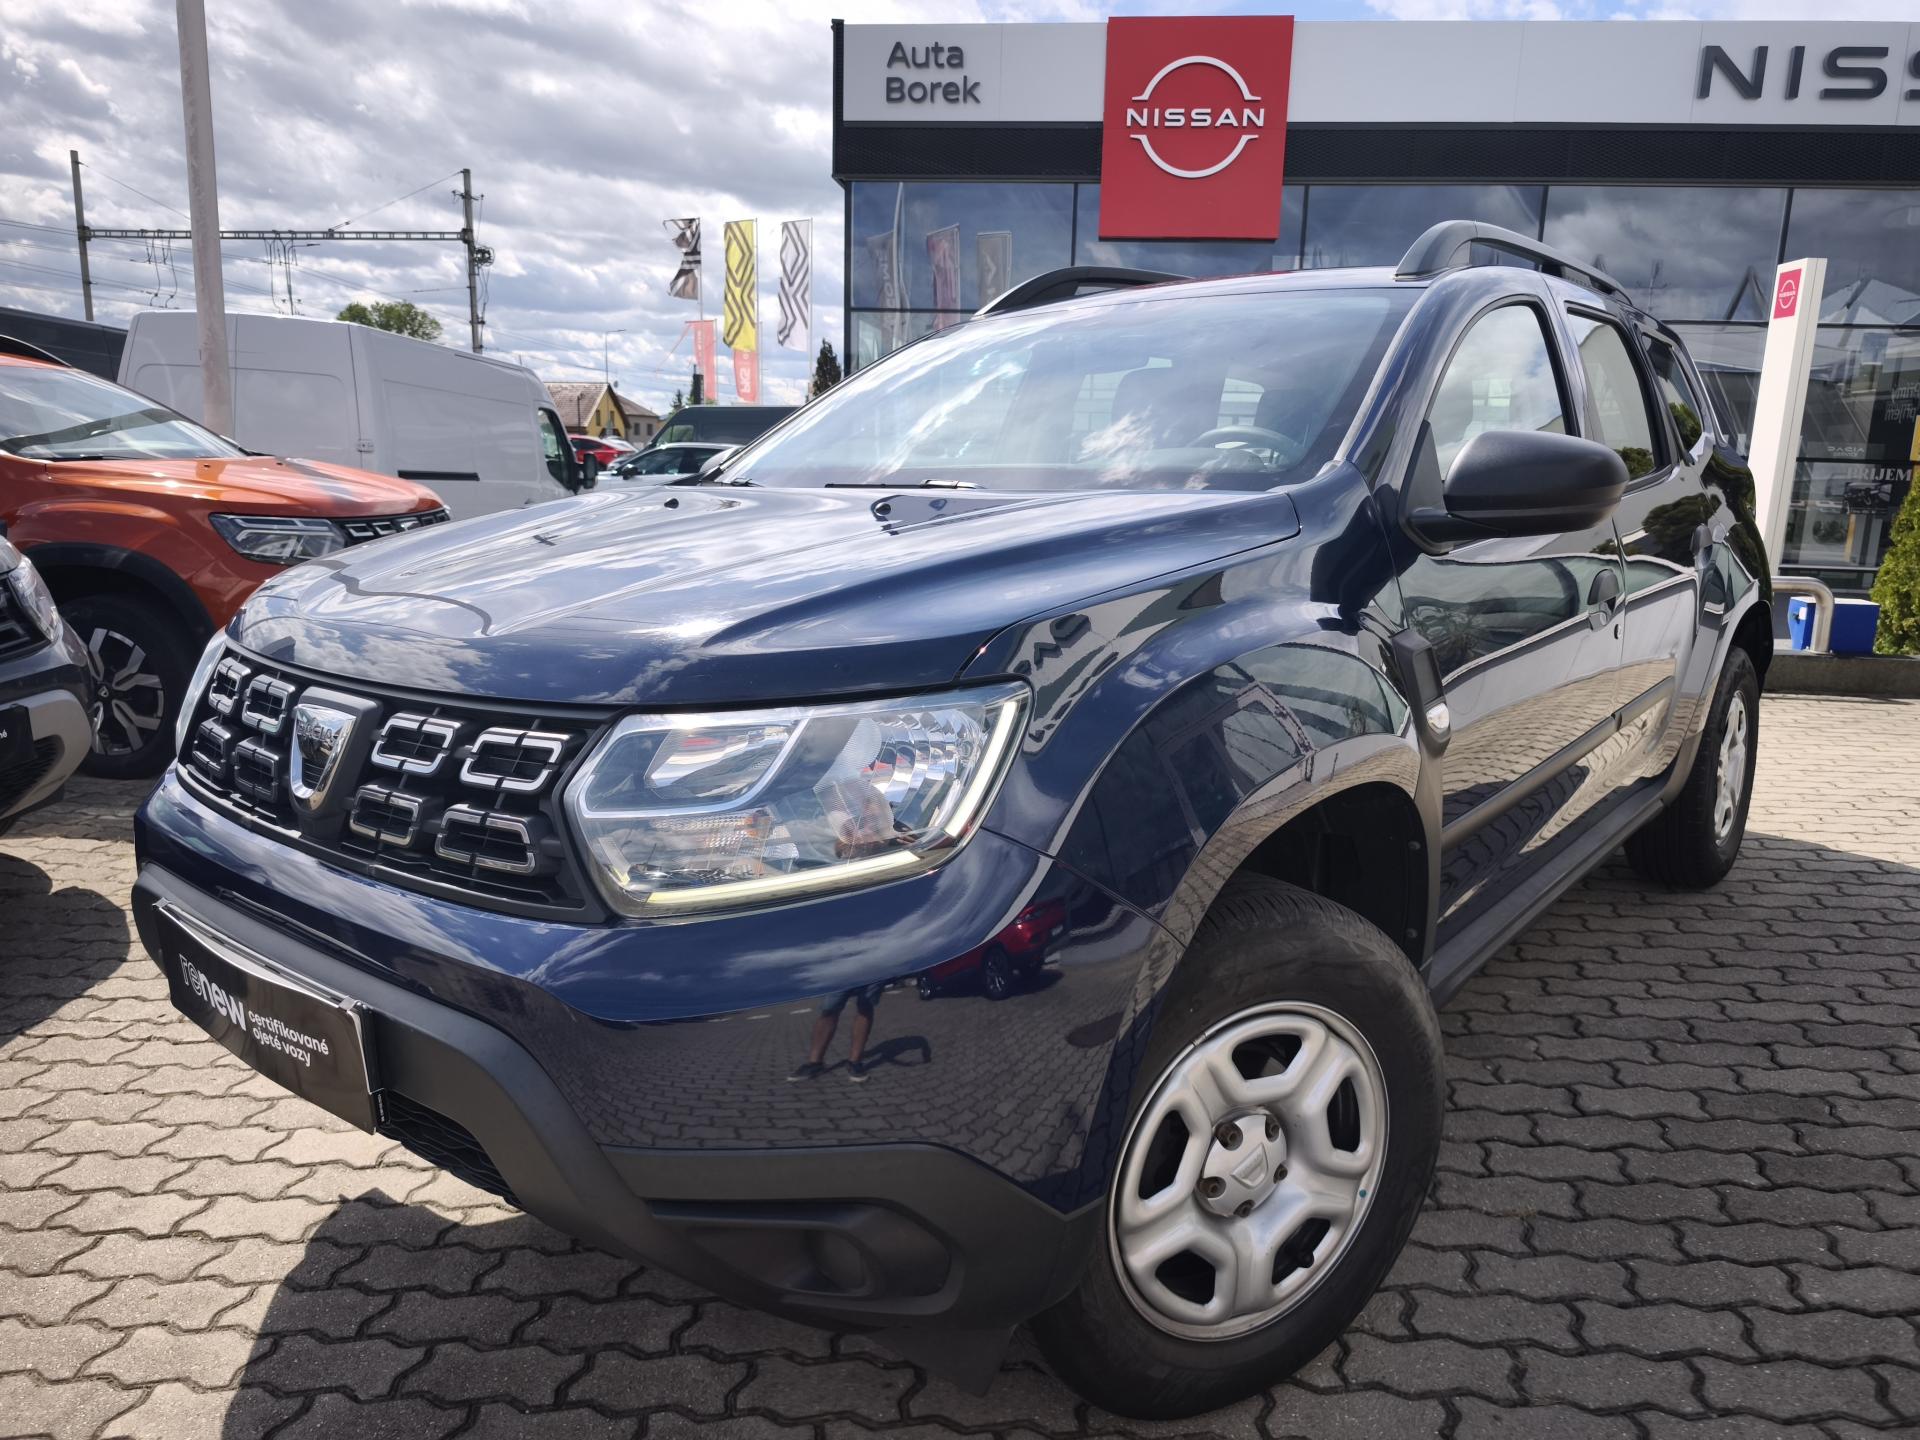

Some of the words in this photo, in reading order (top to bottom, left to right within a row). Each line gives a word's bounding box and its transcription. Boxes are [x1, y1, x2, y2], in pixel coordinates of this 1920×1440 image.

[886, 40, 964, 69] Auta
[1696, 45, 1920, 101] NIS
[885, 75, 981, 104] Borek
[1126, 107, 1265, 128] NISSAN
[178, 954, 247, 1031] renew
[248, 1010, 329, 1056] certifikované
[253, 1025, 282, 1051] ojeté
[282, 1042, 311, 1067] vozy
